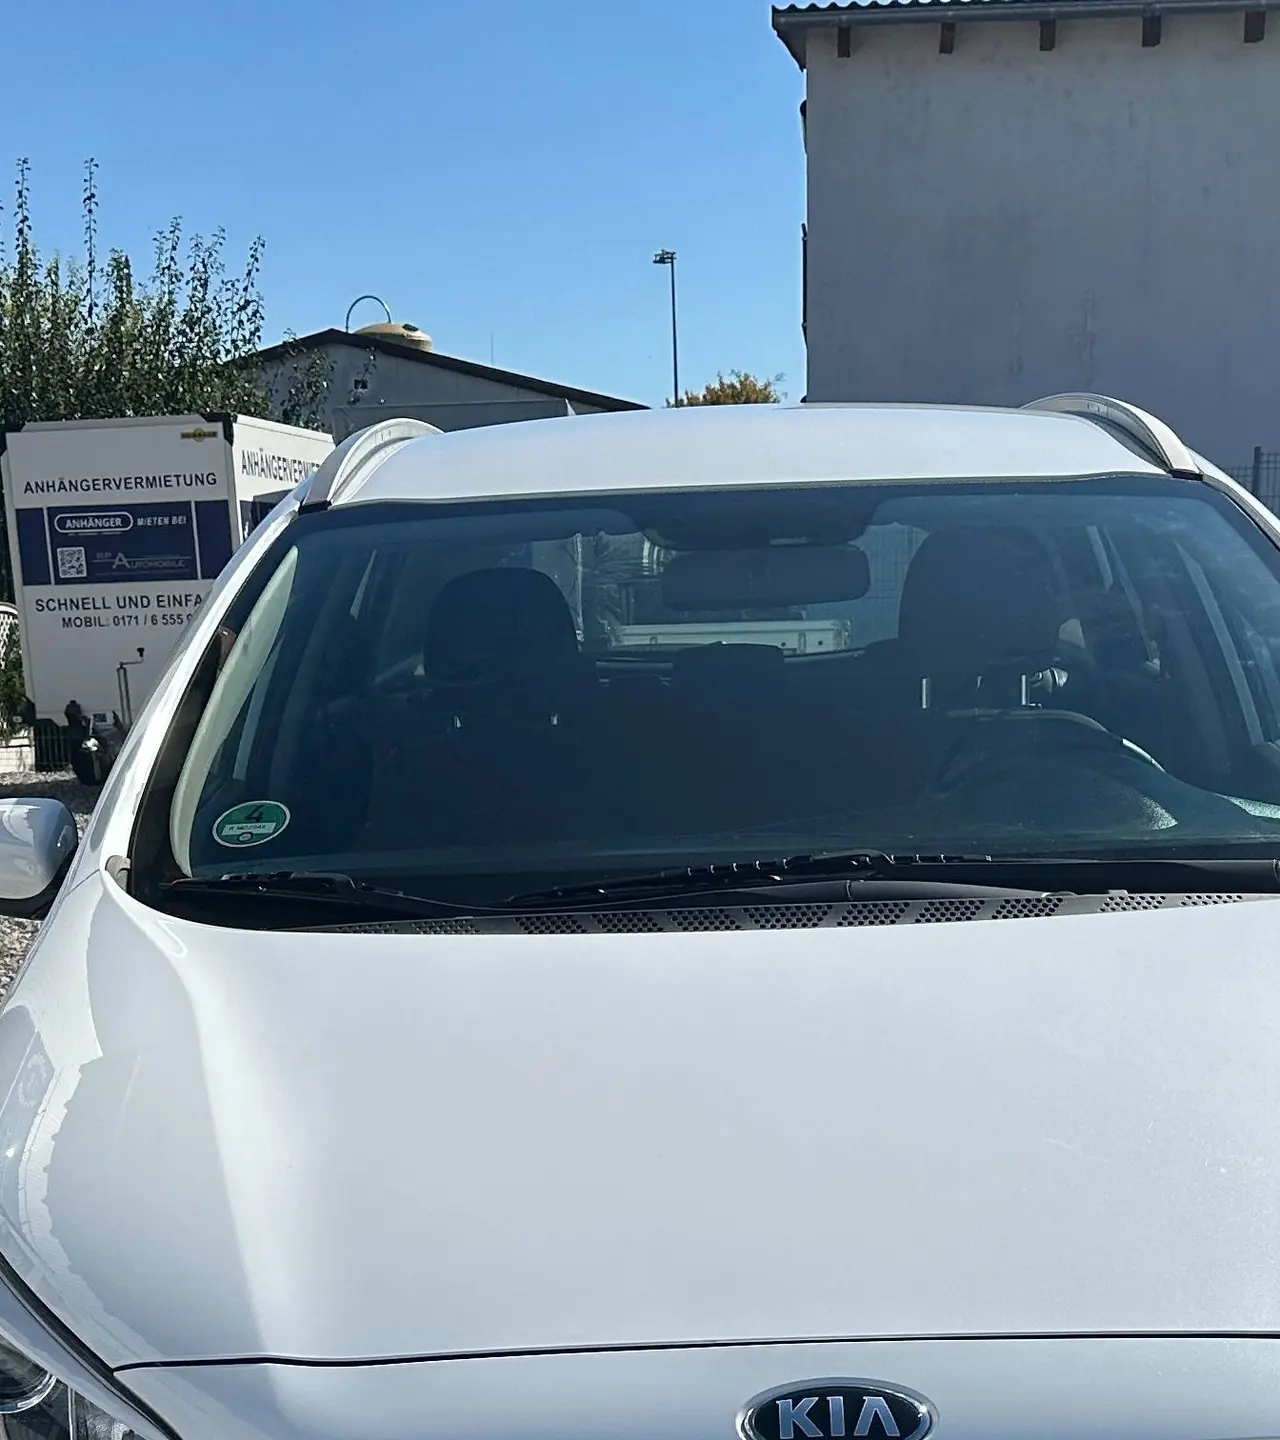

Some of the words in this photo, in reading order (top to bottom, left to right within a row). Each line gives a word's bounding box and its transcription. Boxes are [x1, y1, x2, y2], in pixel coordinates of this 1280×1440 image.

[24, 472, 217, 494] ANHÄNGERVERMIETUNG
[65, 517, 122, 529] ANHÄNGER
[137, 516, 169, 526] MIETEN
[172, 515, 186, 525] BEI
[35, 596, 111, 612] SCHNELL
[117, 595, 150, 609] UND
[62, 615, 109, 628] MOBIL:
[113, 614, 139, 627] 0171
[151, 614, 158, 625] 6
[162, 614, 184, 626] 555
[245, 805, 264, 824] 4
[776, 1396, 901, 1439] KIA
